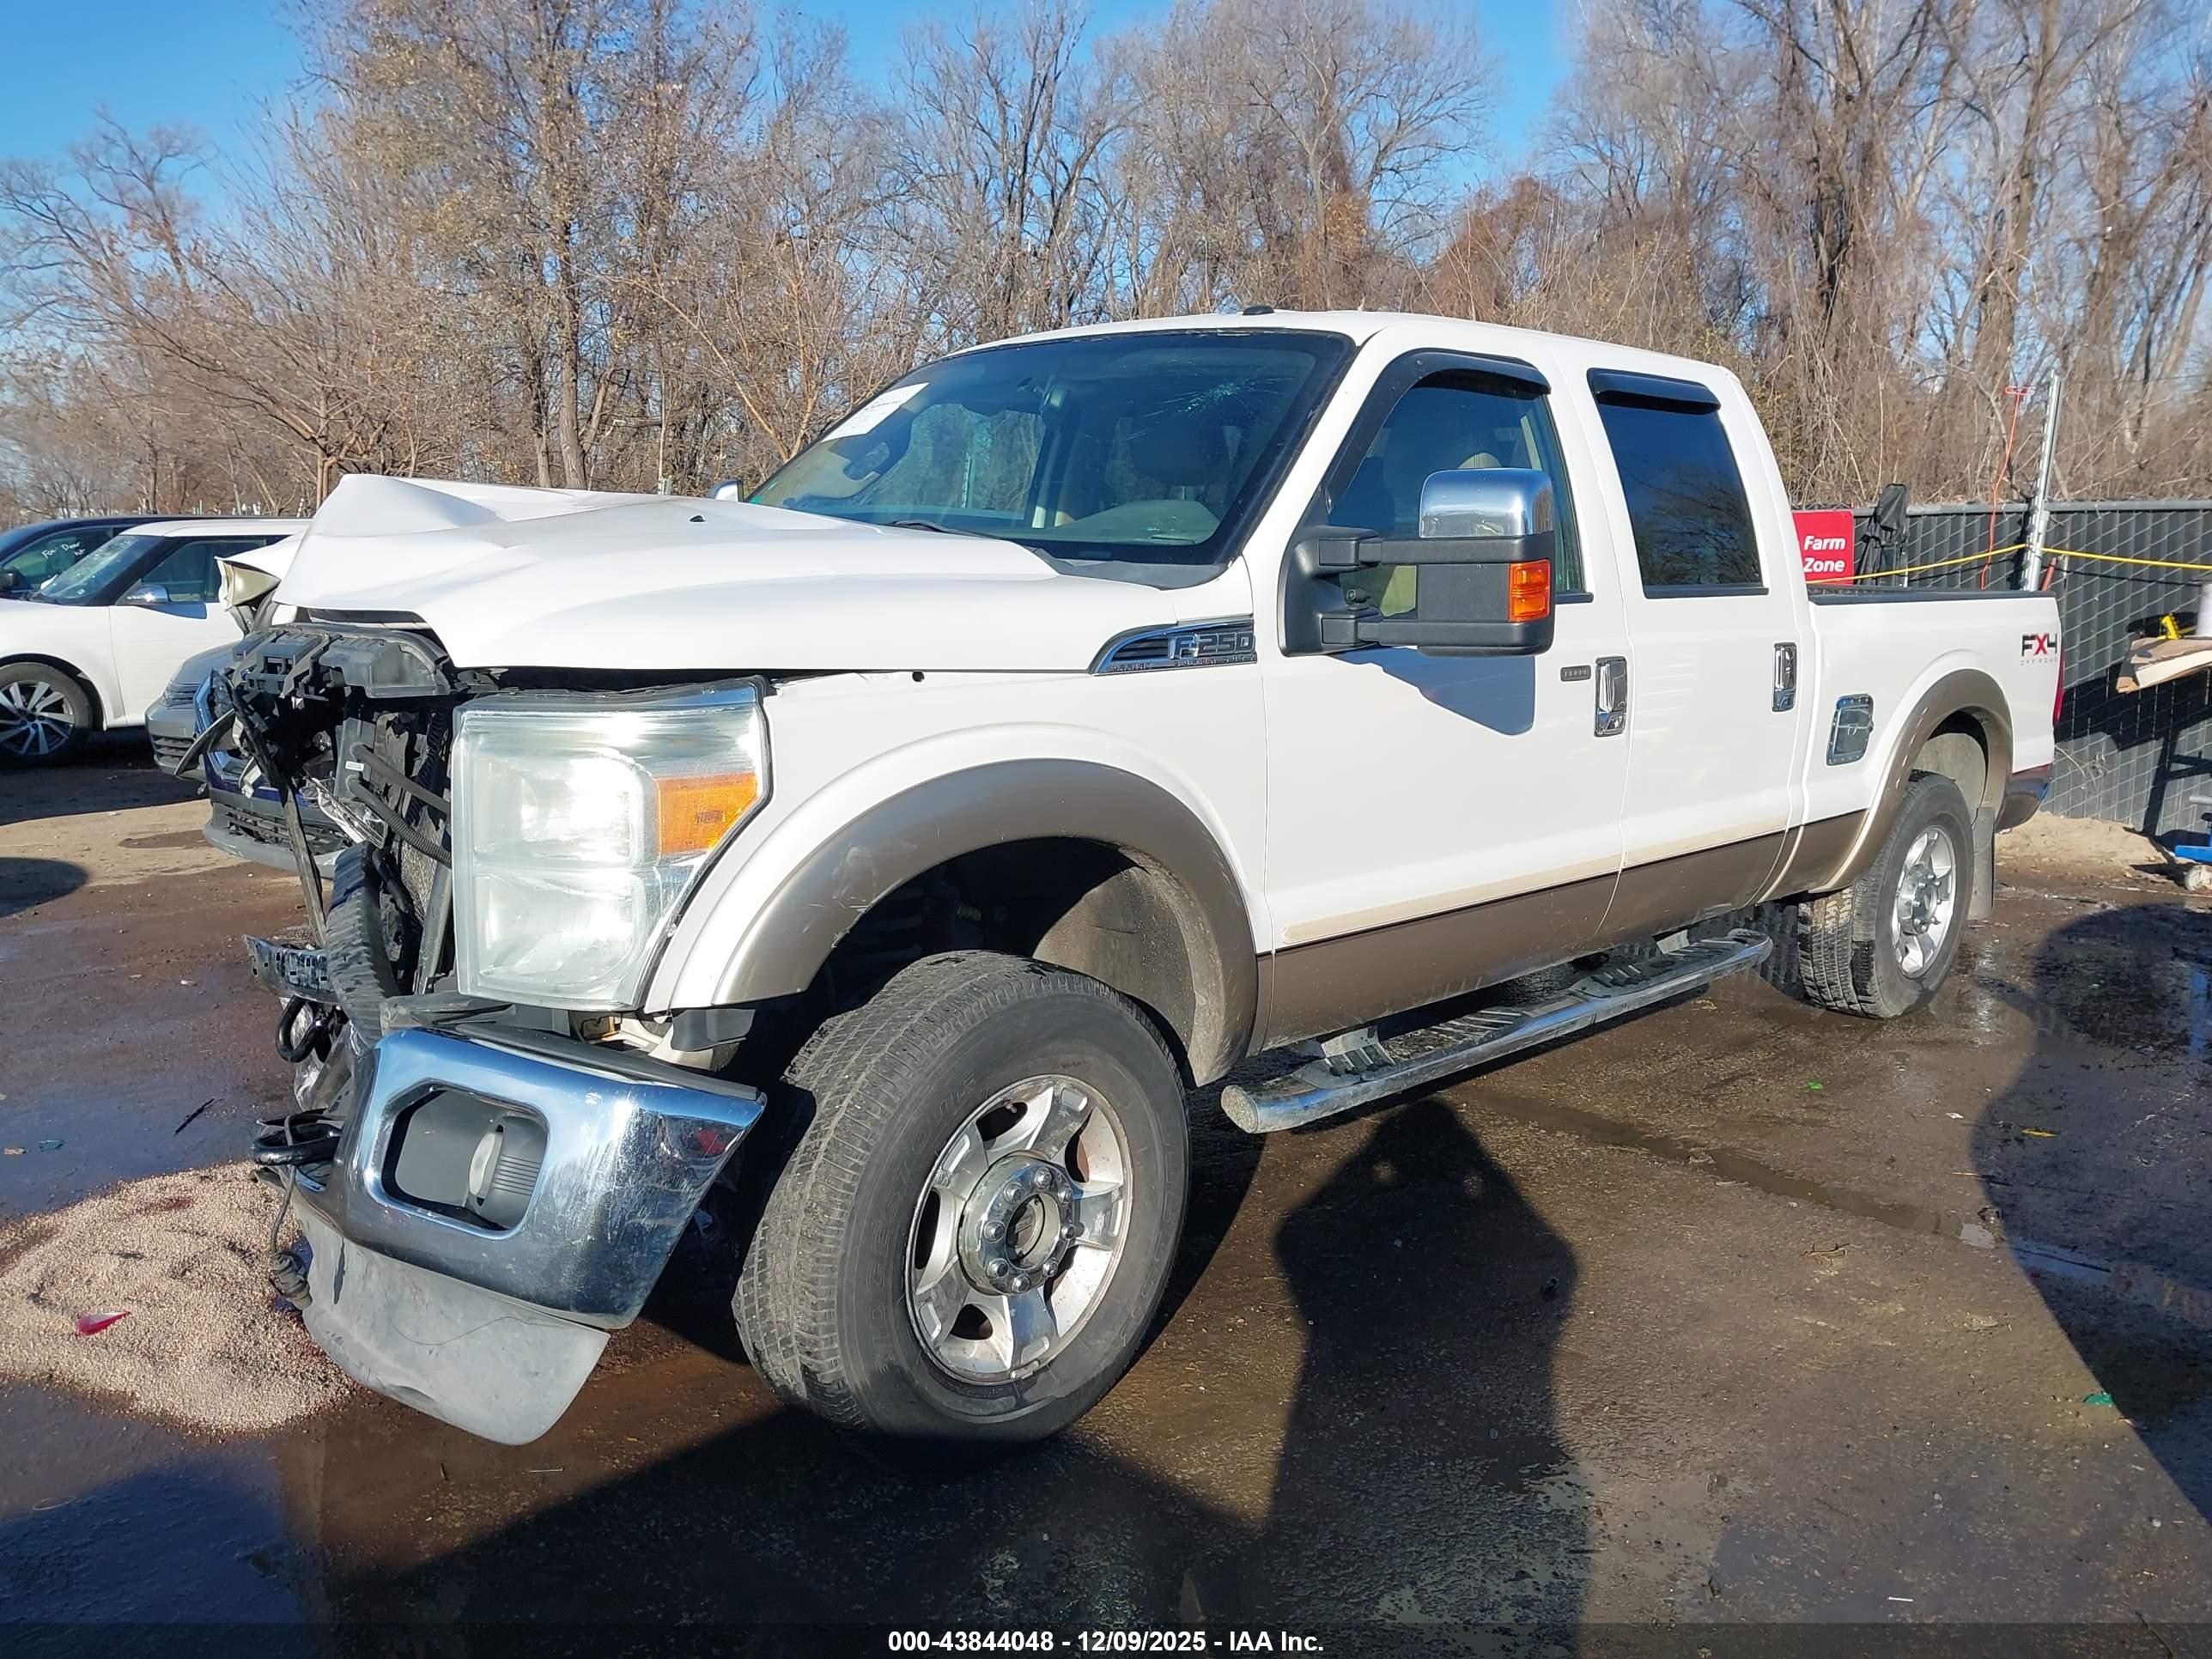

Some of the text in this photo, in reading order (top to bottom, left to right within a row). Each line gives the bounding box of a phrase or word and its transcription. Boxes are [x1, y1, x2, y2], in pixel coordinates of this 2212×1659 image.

[1803, 535, 1846, 550] Farm
[1802, 557, 1845, 573] Zone
[2021, 632, 2057, 657] FX4
